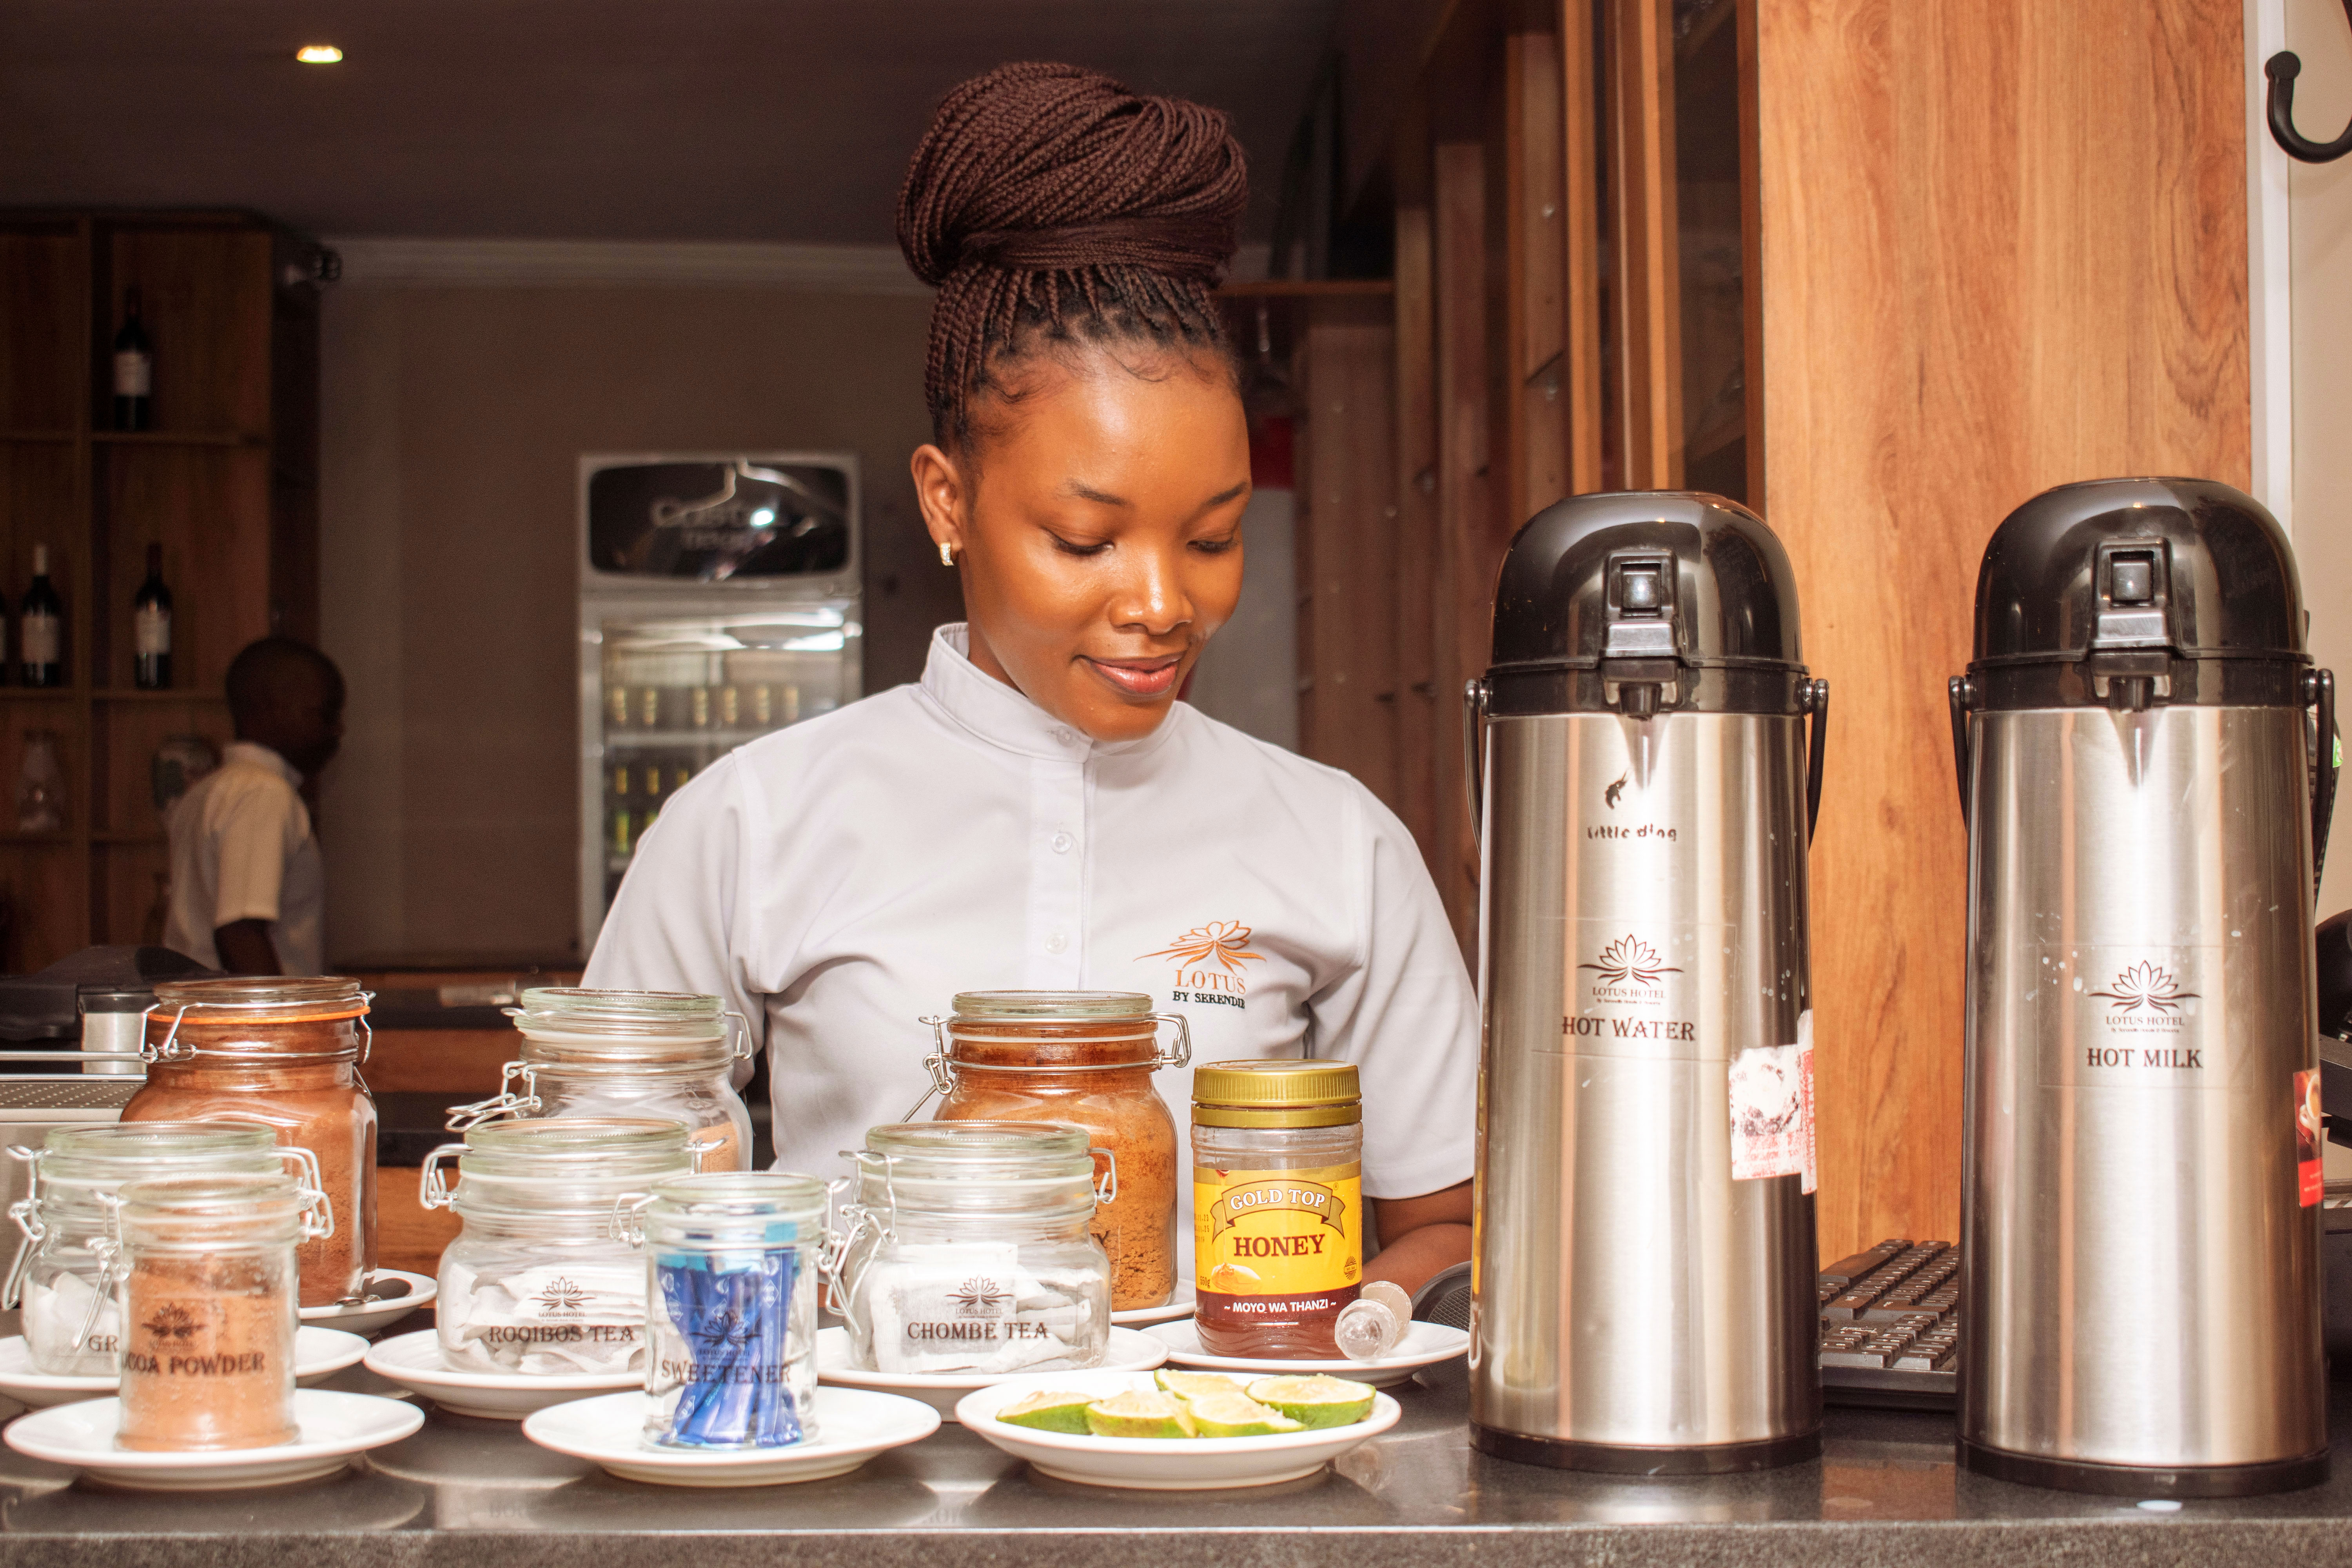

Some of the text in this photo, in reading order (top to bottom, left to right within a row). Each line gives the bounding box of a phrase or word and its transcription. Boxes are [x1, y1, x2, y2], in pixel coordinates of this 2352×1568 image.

[1175, 969, 1246, 995] LOTUS
[1173, 991, 1189, 1002] BY
[1592, 987, 1666, 998] LOTUS HOTEL
[1562, 1016, 1695, 1042] HOT WATER
[2106, 1016, 2185, 1026] LOTUS HOTEL
[2087, 1047, 2203, 1068] HOT MILK
[1230, 1189, 1283, 1210] GOLD
[1288, 1189, 1325, 1208] TOP
[1233, 1234, 1325, 1257] HONEY
[1200, 1276, 1210, 1289] 550g
[1233, 1298, 1328, 1312] MOYO WA THANZI
[589, 1325, 637, 1342] TEA
[908, 1322, 1050, 1339] CHOMBE TEA
[169, 1351, 265, 1376] POWDER
[661, 1359, 791, 1383] SWEETENER
